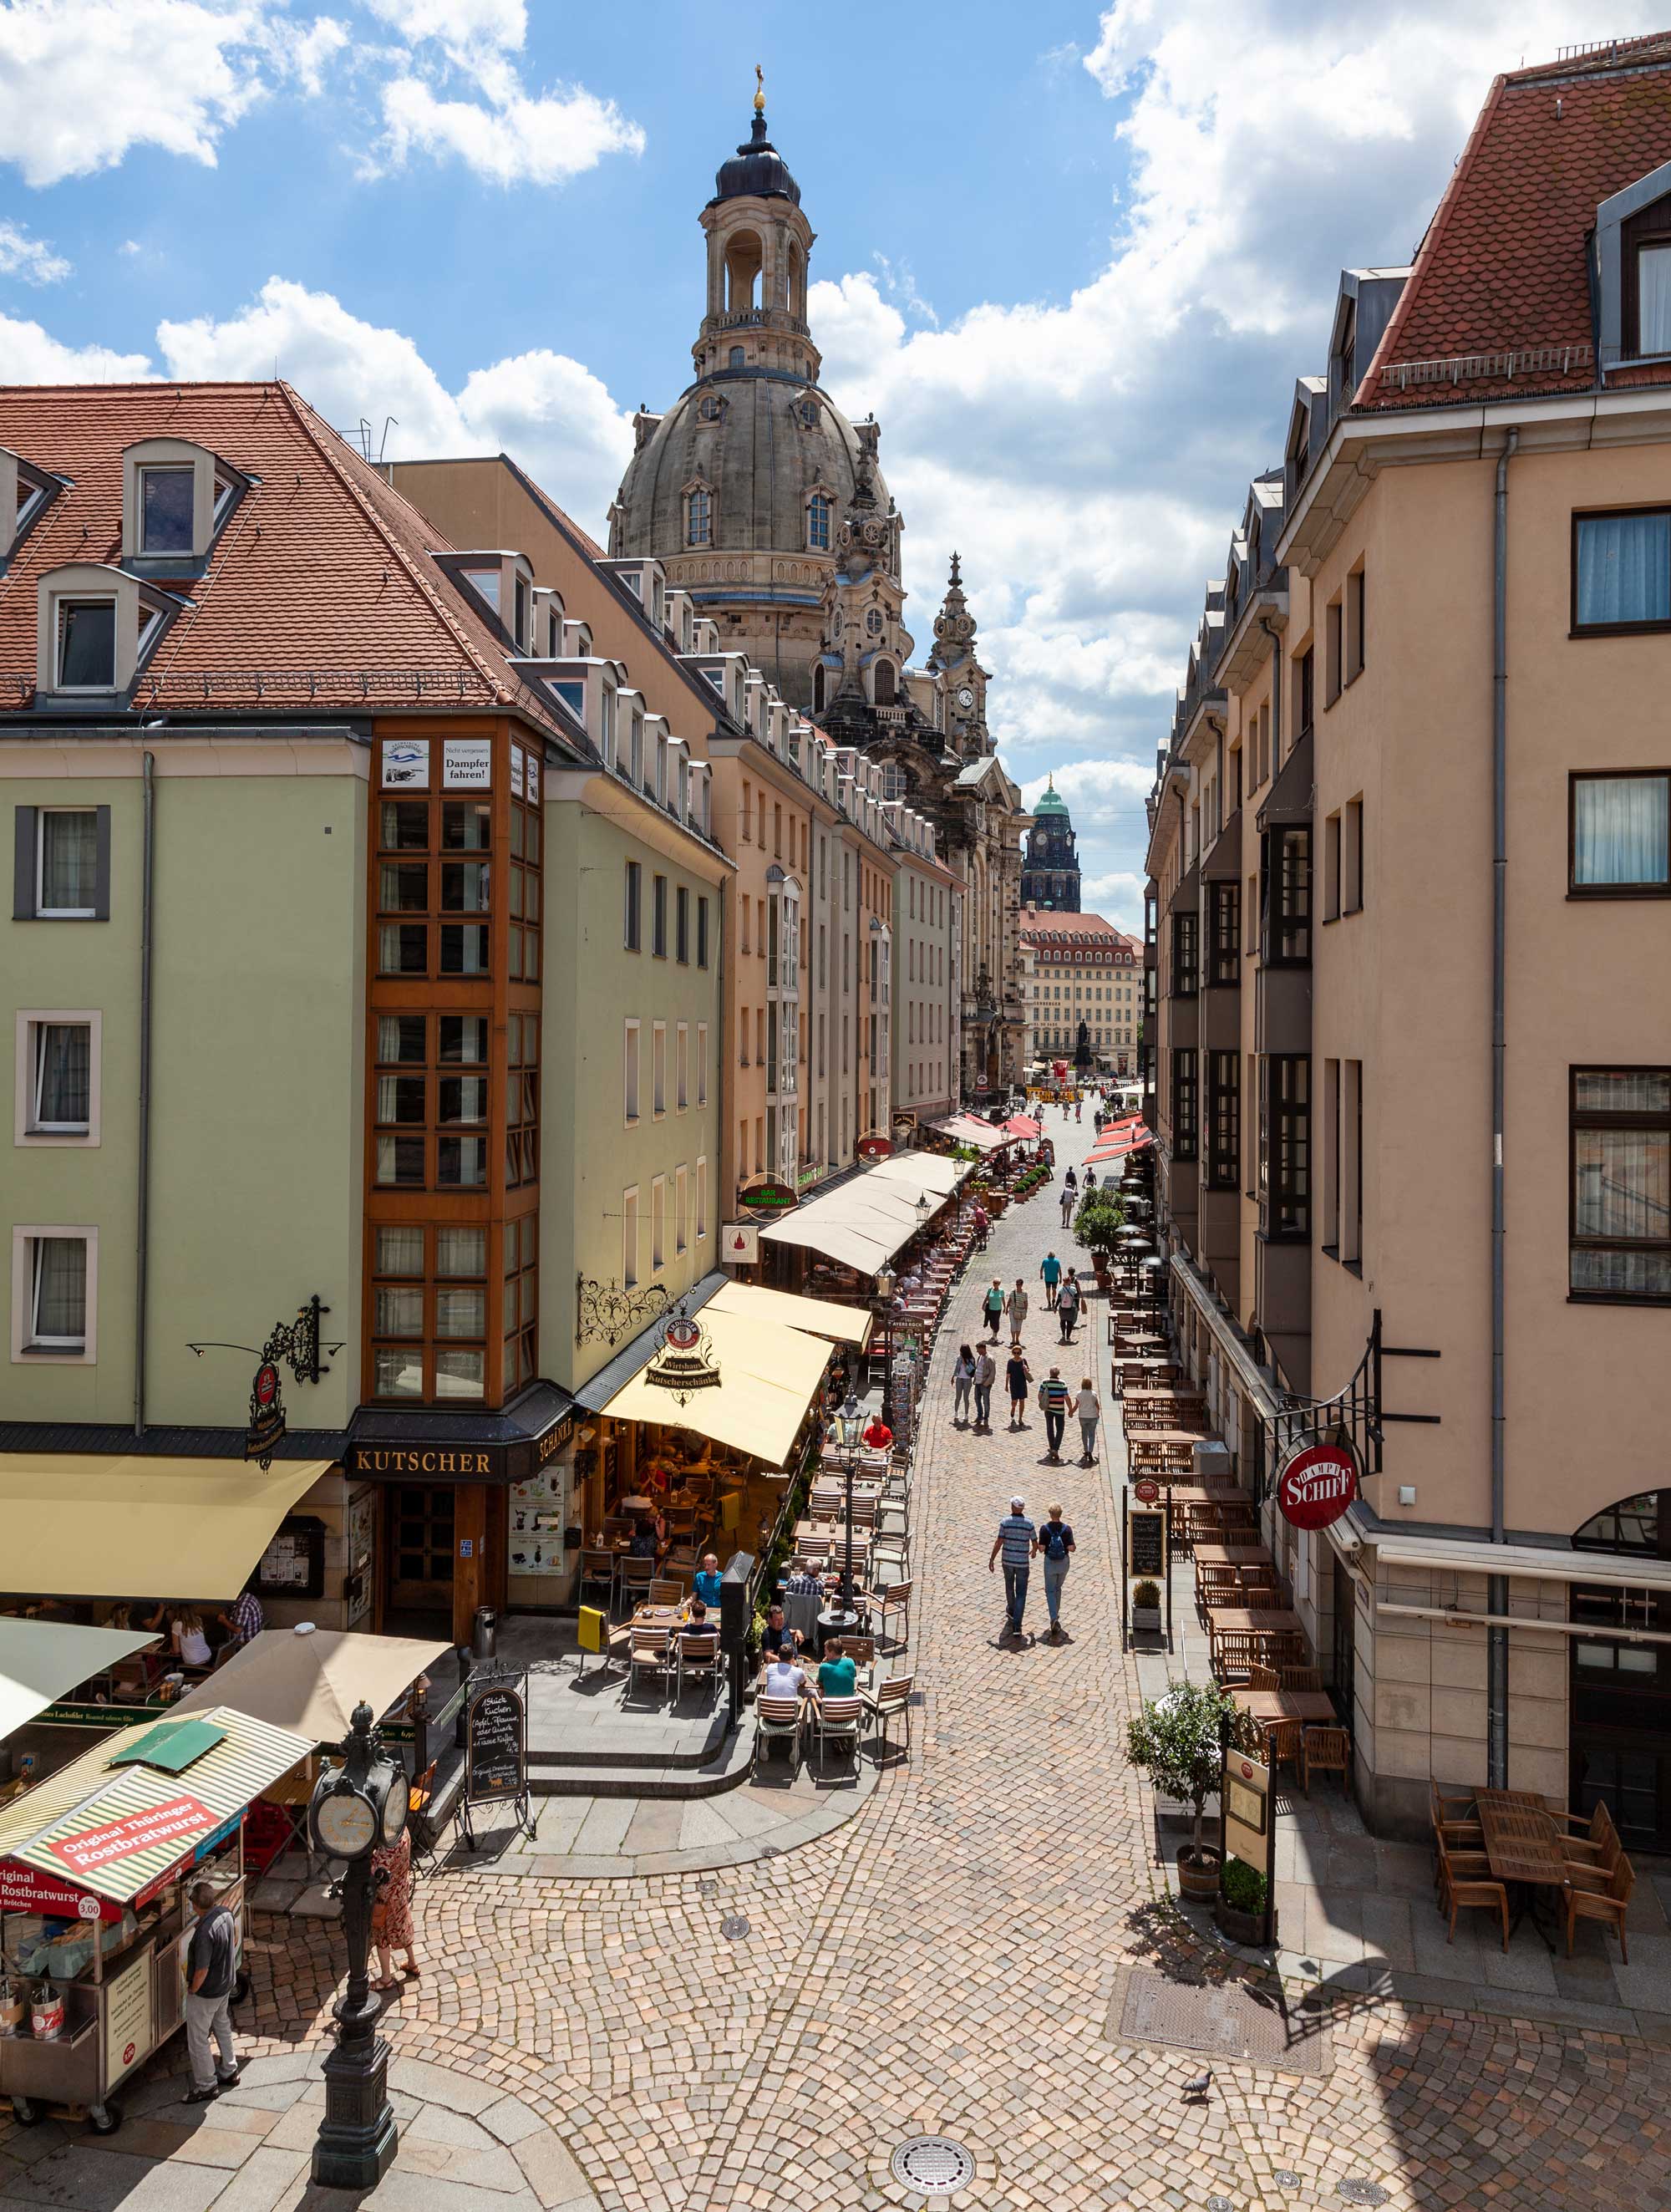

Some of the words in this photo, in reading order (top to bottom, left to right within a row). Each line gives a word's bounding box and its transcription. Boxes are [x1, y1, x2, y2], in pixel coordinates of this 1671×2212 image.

[446, 759, 490, 769] Dampfer
[449, 770, 485, 779] fahren!
[668, 1320, 698, 1333] ERDINGER
[665, 1360, 702, 1370] Wirtshaus
[648, 1372, 717, 1386] Kutscherschänke
[356, 1451, 491, 1472] KUTSCHER
[1301, 1463, 1340, 1482] DAMPF
[485, 1706, 511, 1716] Kuchen
[63, 1825, 125, 1855] Original
[124, 1802, 194, 1832] Thüringer
[74, 1811, 208, 1867] Rostbratwurst
[1, 1884, 79, 1903] Rostbratwurst
[3, 1899, 32, 1908] Brötchen
[80, 1904, 99, 1915] 3,00
